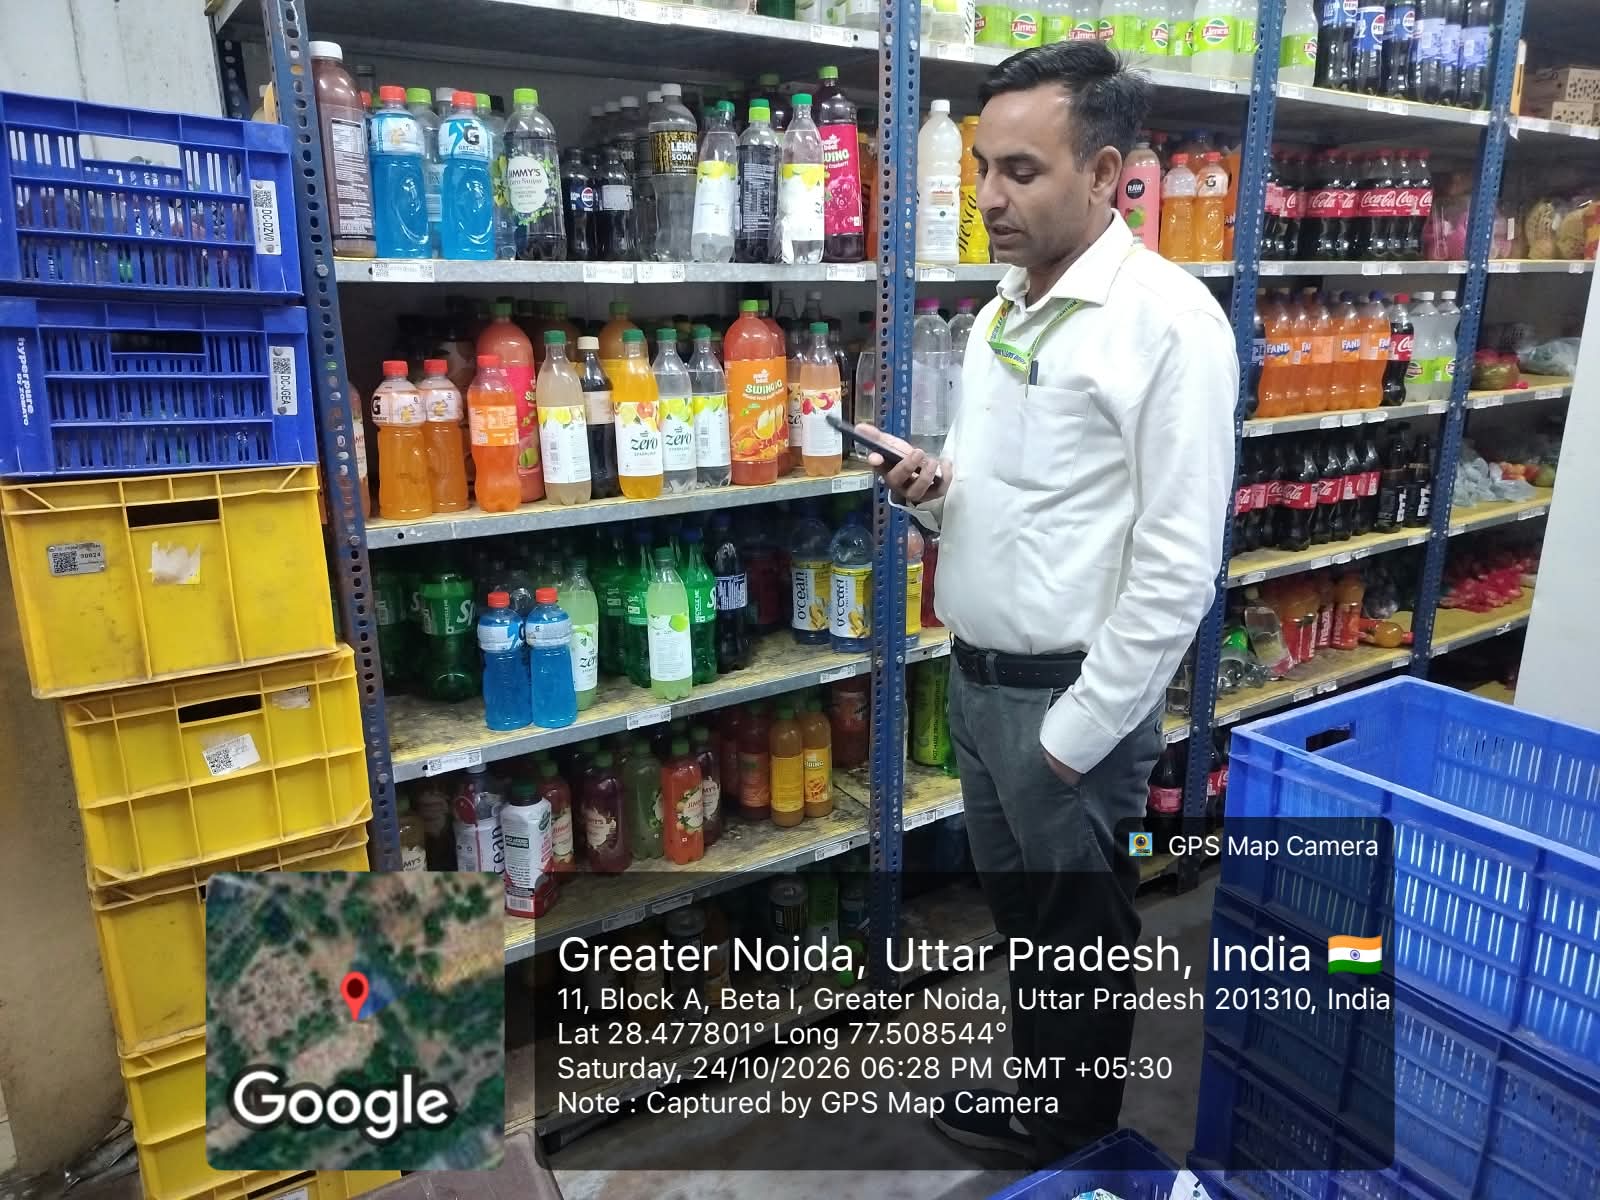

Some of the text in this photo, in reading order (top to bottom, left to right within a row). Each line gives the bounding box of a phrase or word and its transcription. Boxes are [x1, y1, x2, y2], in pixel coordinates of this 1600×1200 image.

[1127, 183, 1144, 192] RAW
[630, 438, 658, 451] zero
[666, 432, 692, 446] zero
